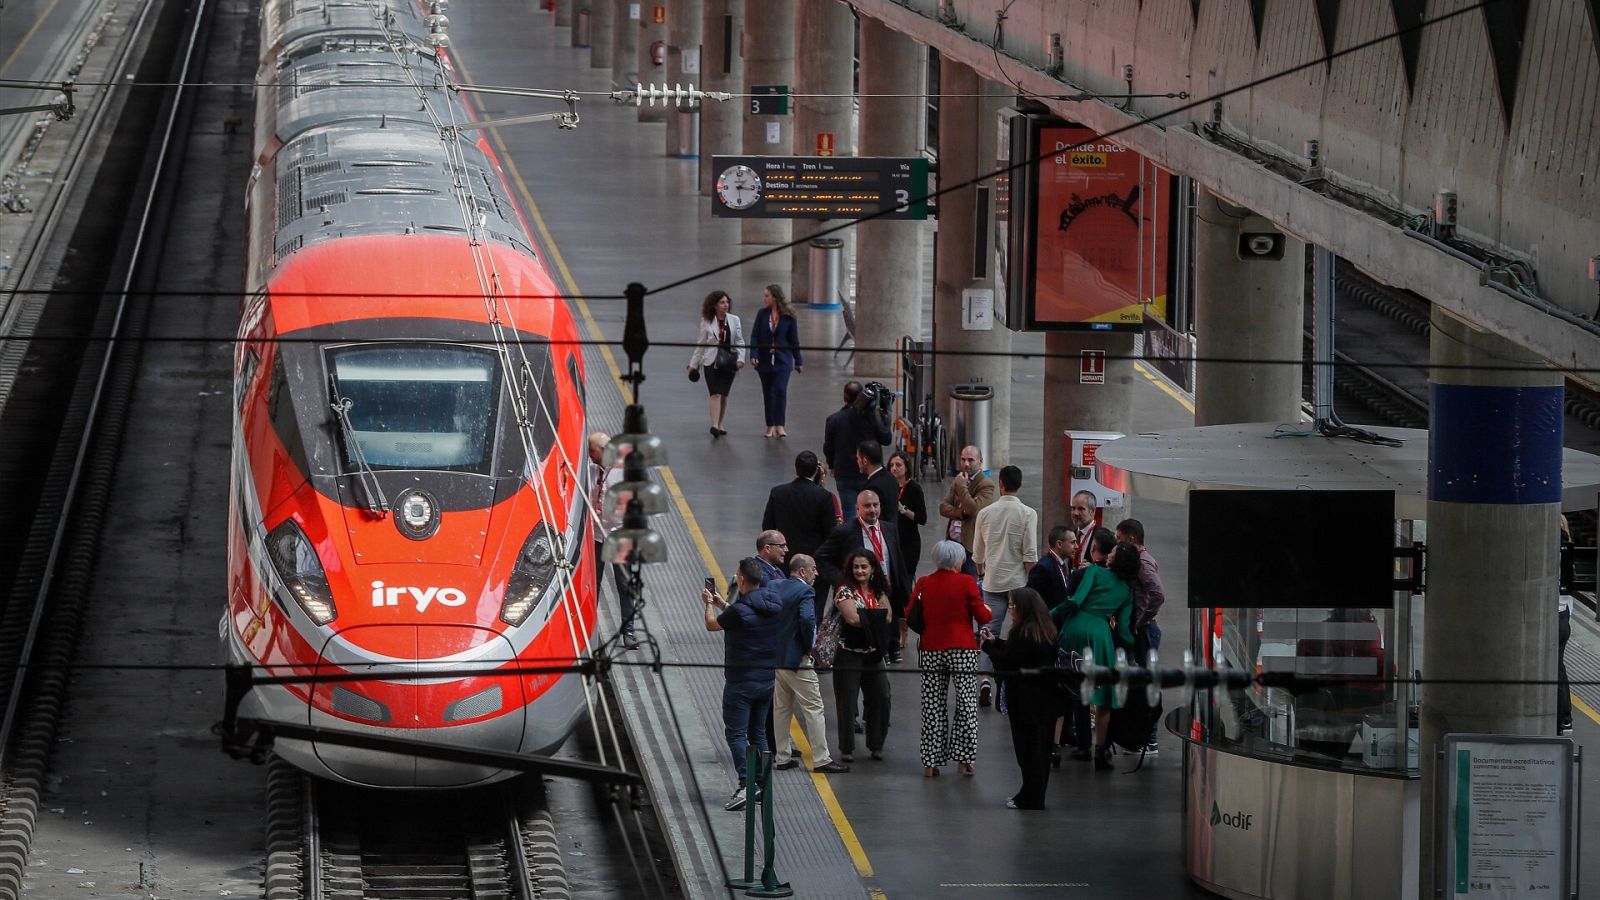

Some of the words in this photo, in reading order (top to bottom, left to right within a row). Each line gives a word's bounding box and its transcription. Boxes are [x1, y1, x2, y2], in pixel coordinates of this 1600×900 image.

[751, 100, 760, 114] 3
[1056, 142, 1096, 152] Donde
[1097, 144, 1126, 152] nace
[1055, 154, 1067, 164] el
[1072, 154, 1104, 164] éxito.
[895, 190, 909, 212] 3
[371, 580, 467, 613] iryo
[1222, 811, 1253, 830] adif
